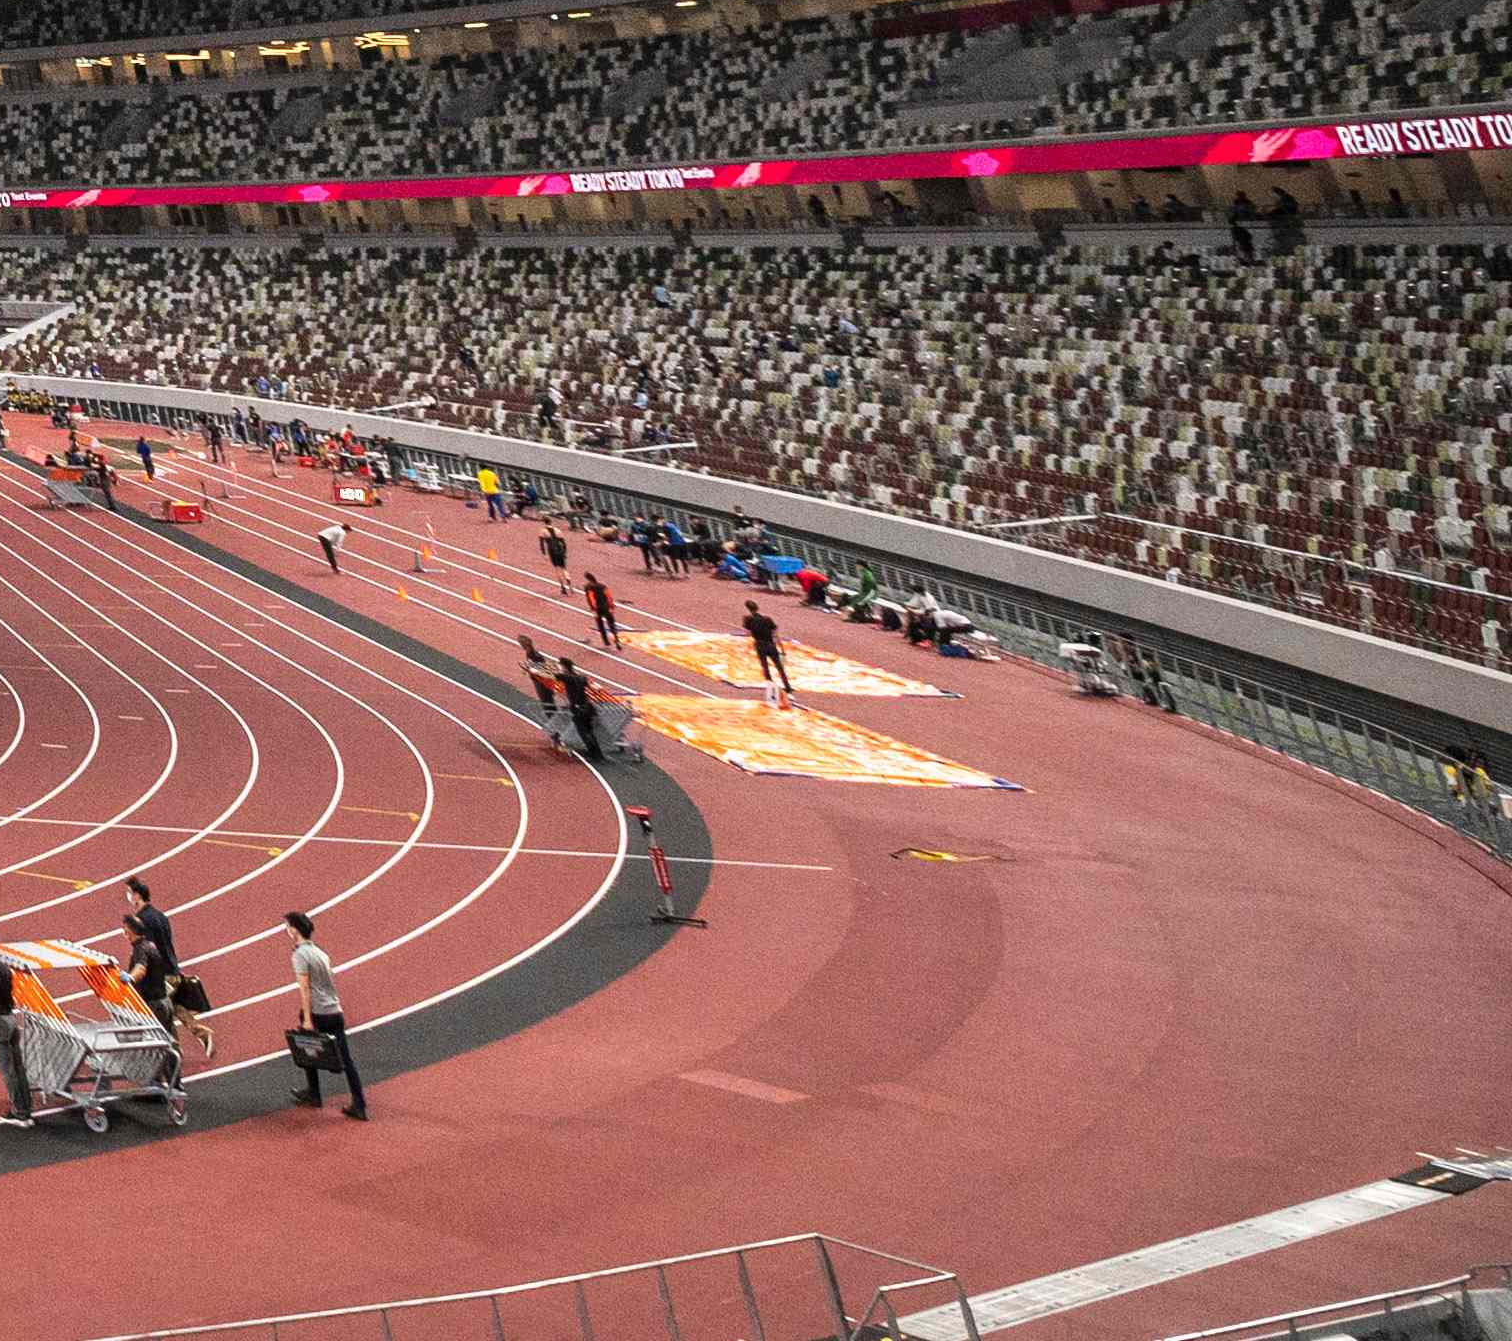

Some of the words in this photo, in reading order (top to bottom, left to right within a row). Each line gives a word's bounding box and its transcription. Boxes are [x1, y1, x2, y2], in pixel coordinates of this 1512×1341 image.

[1336, 122, 1404, 155] READY
[1401, 117, 1484, 151] STEADY
[1478, 114, 1512, 147] TO
[570, 172, 607, 192] READY
[606, 171, 647, 191] STEADY
[646, 168, 684, 189] TOKYO
